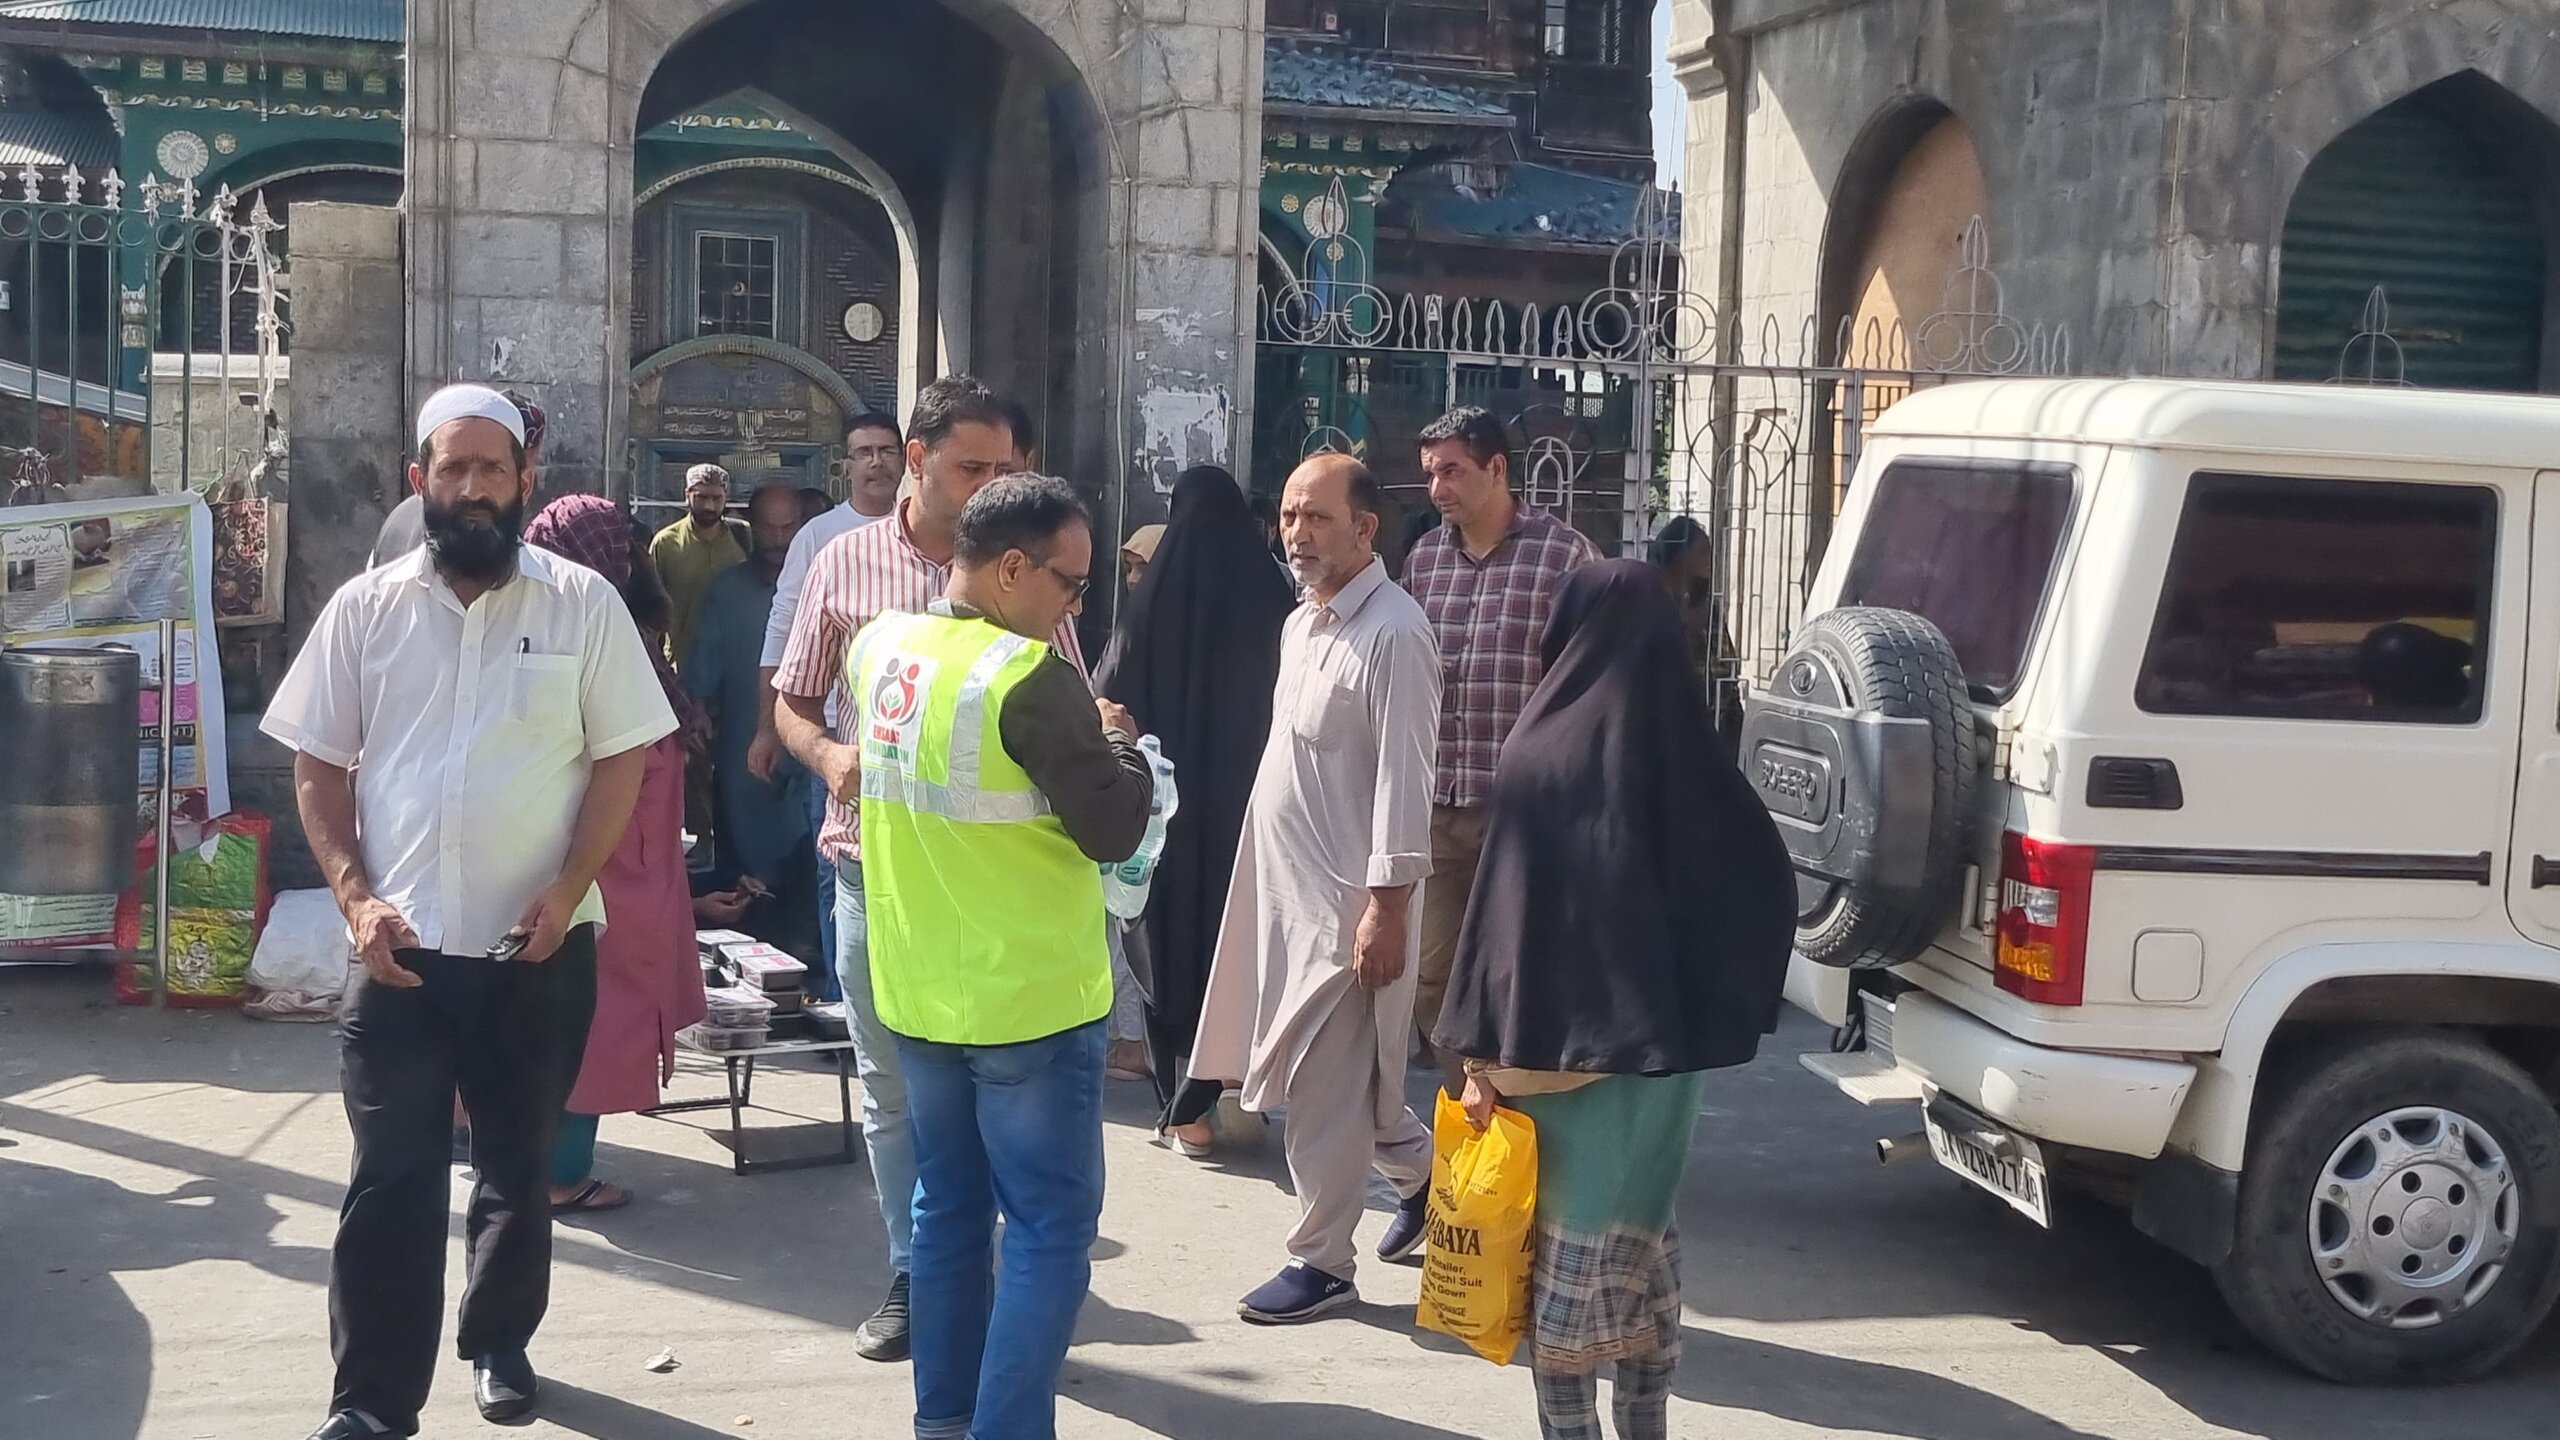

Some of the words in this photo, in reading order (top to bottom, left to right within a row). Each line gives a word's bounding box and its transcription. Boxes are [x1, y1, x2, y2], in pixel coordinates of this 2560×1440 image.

[1760, 758, 1817, 802] BOLERO
[1459, 1276, 1483, 1288] Suit
[1436, 1285, 1467, 1299] Gown
